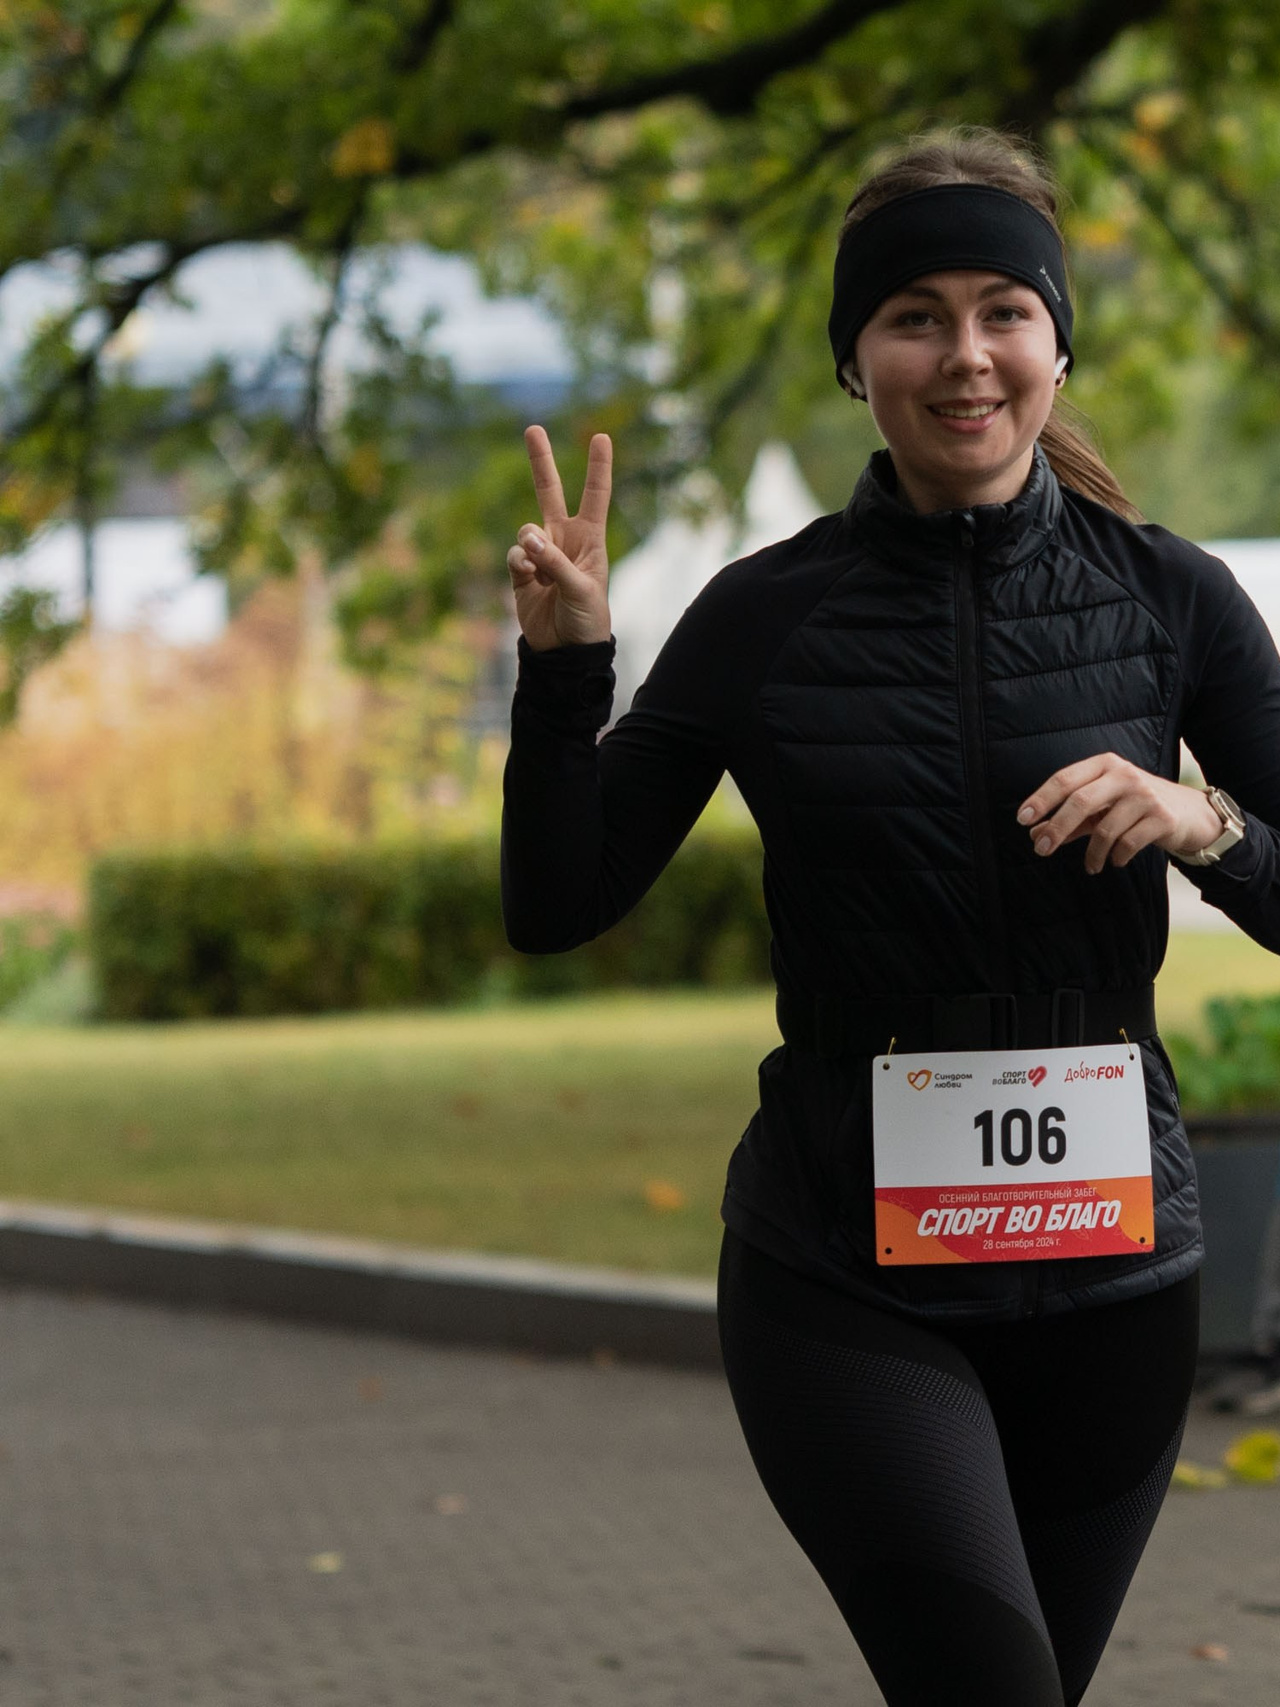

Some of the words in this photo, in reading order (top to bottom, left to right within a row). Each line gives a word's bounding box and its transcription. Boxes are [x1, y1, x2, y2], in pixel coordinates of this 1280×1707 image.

[934, 1072, 973, 1081] Синдром
[1002, 1070, 1027, 1079] СПОРТ
[934, 1081, 962, 1089] любви
[974, 1106, 1067, 1167] 106
[938, 1190, 980, 1204] ОСЕННИЙ
[982, 1187, 1072, 1202] БЛАГОТВОРИТЕЛЬНЫЙ
[1073, 1186, 1098, 1198] ЗАБЕГ
[917, 1206, 1005, 1237] СПОРТ
[1004, 1204, 1043, 1234] ВО
[1044, 1199, 1122, 1232] БЛАГО
[983, 1239, 994, 1250] 28
[995, 1238, 1034, 1250] сентября
[1035, 1236, 1054, 1247] 2024
[1055, 1239, 1062, 1247] г.
